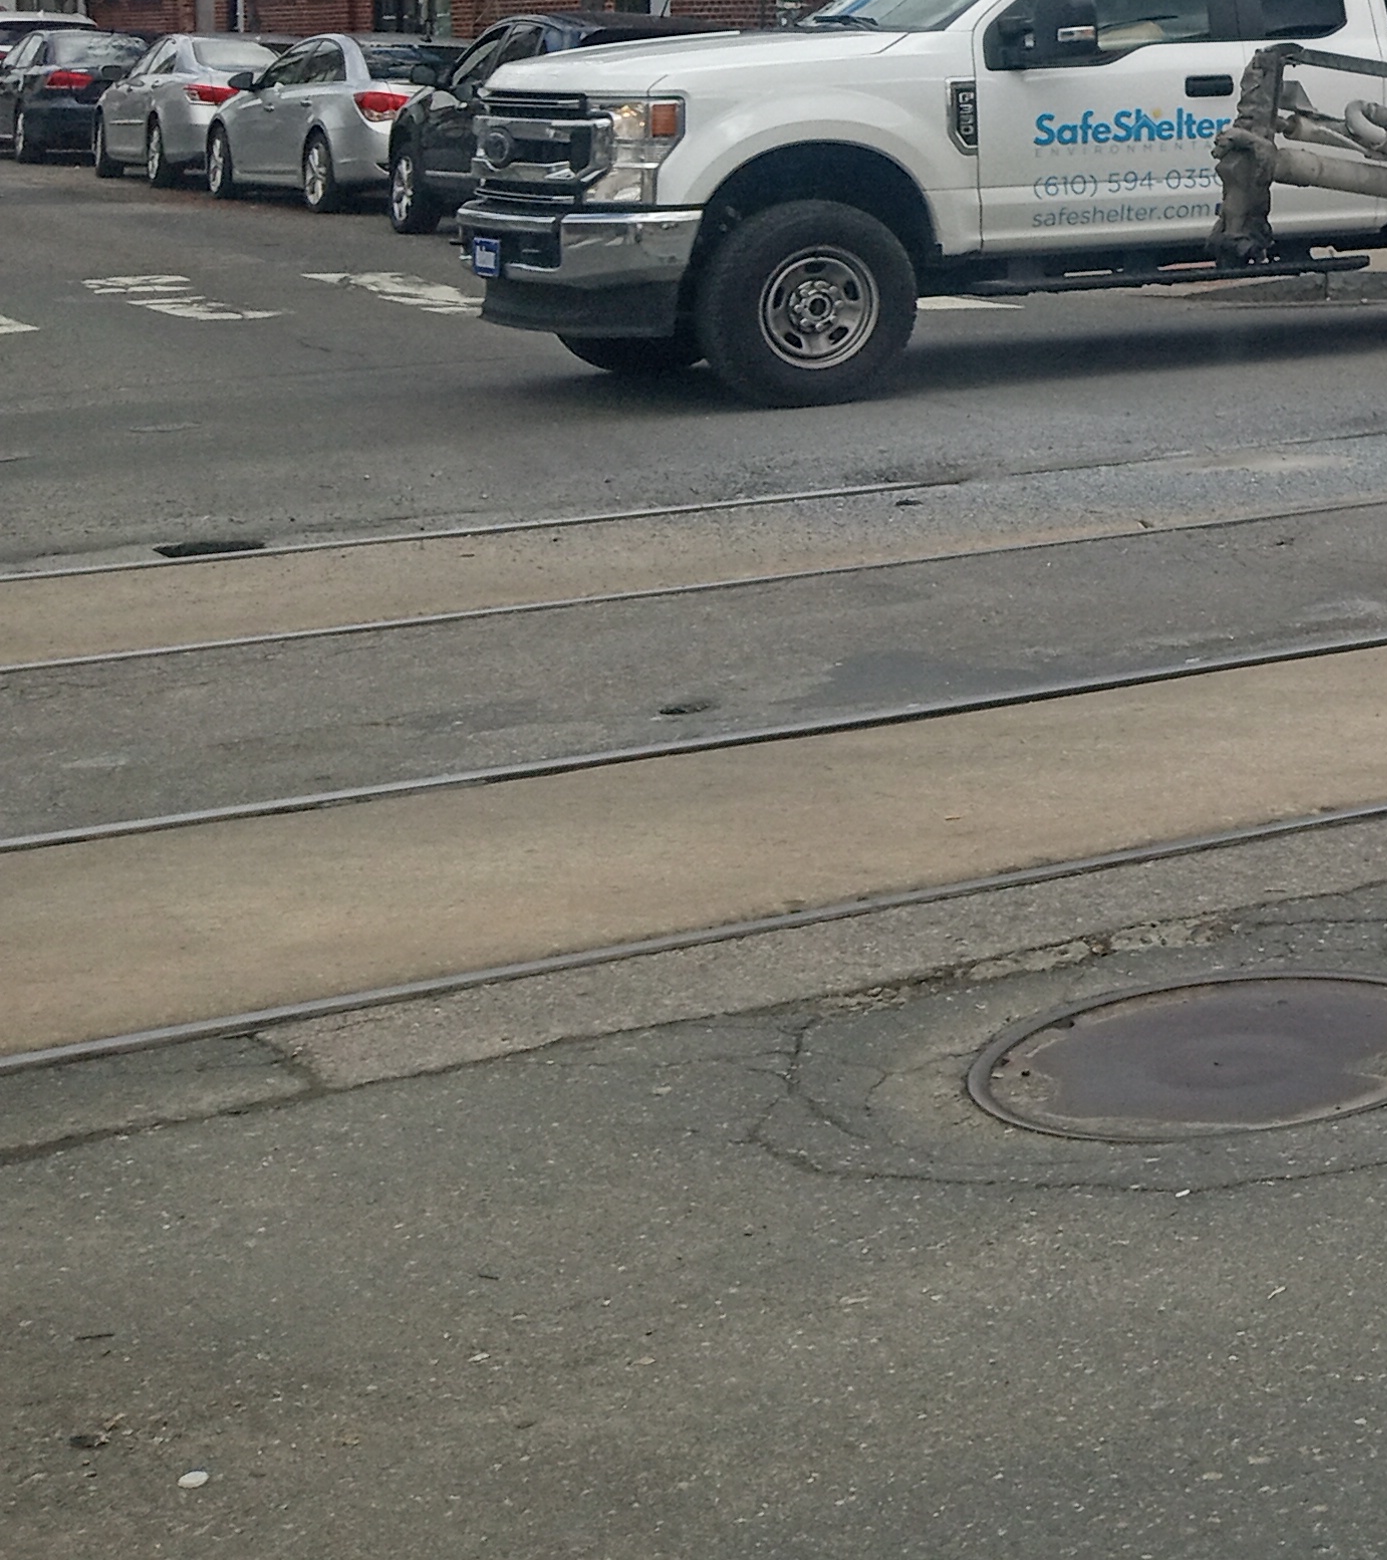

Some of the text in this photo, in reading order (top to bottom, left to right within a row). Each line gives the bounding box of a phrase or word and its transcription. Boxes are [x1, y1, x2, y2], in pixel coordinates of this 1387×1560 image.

[1033, 107, 1231, 146] SafeShelter
[1033, 174, 1098, 200] (610)
[1032, 203, 1211, 229] safeshelter.com
